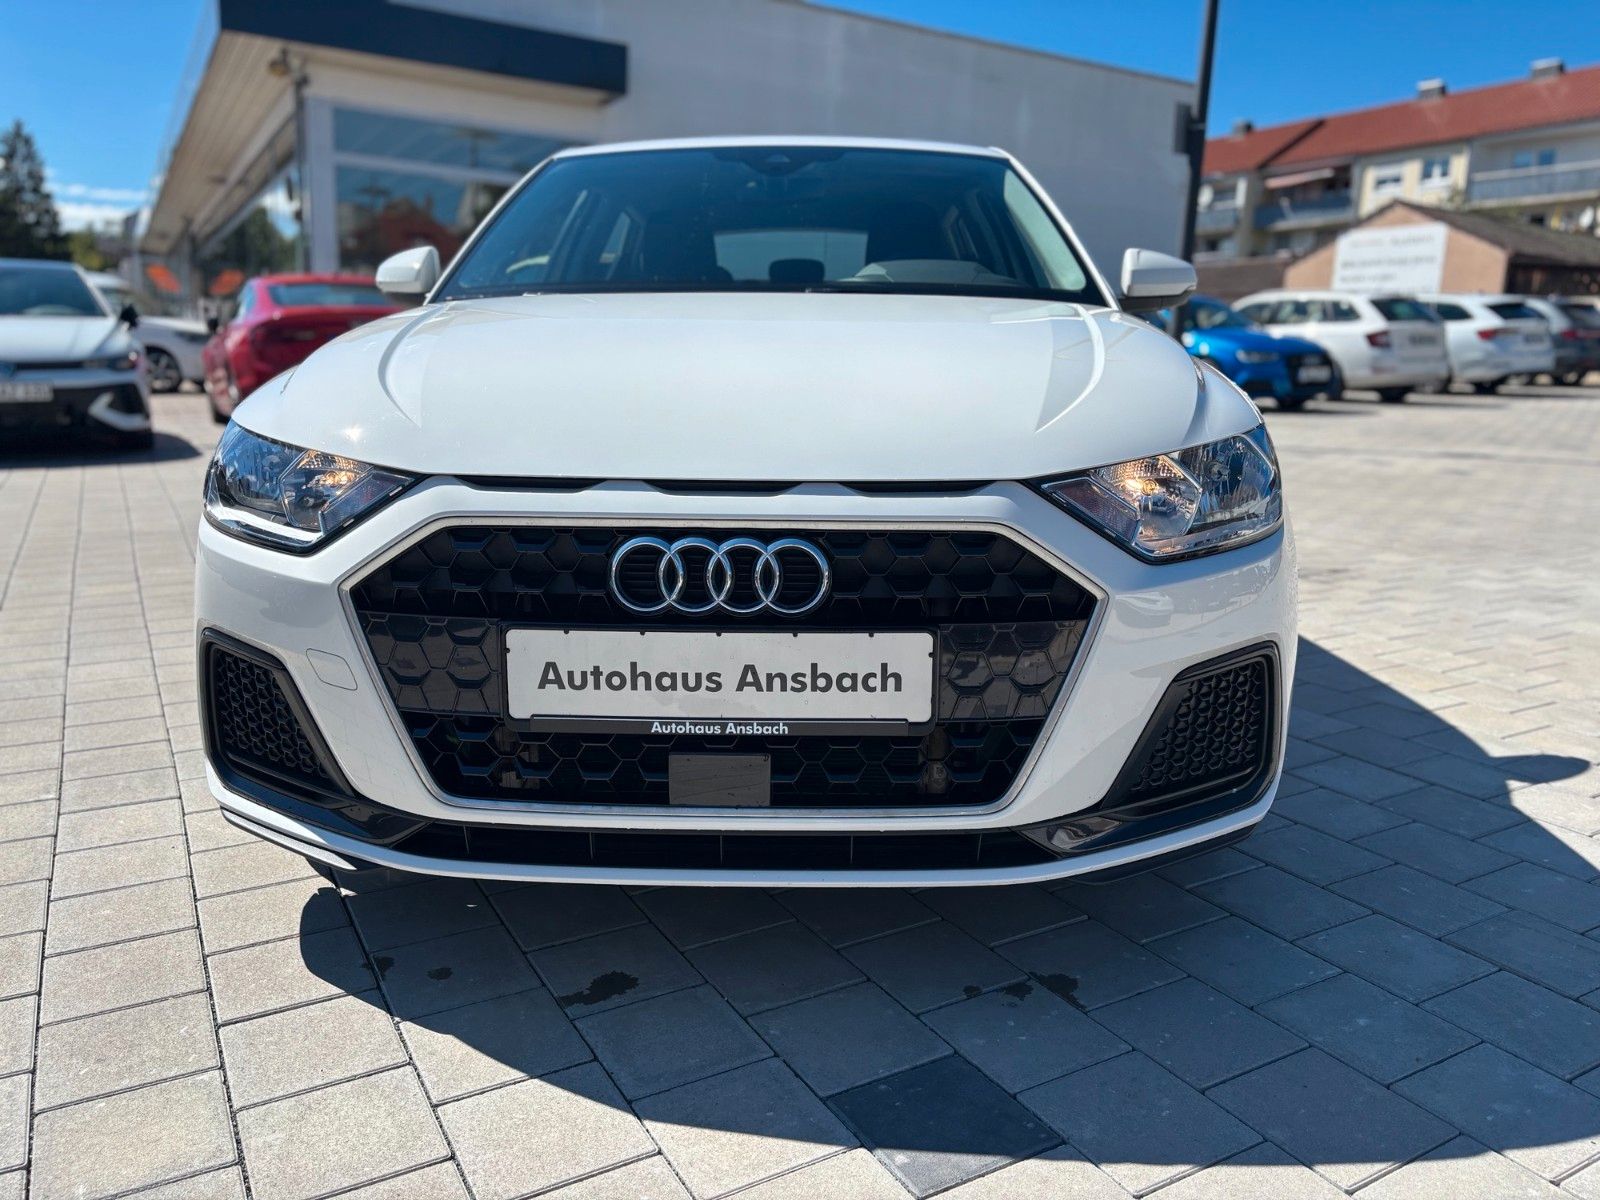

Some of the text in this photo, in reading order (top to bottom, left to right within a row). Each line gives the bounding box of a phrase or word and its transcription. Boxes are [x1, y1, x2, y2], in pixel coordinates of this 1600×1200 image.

[537, 661, 902, 693] Autohaus Ansbach
[650, 721, 789, 735] Autohaus Ansbach
